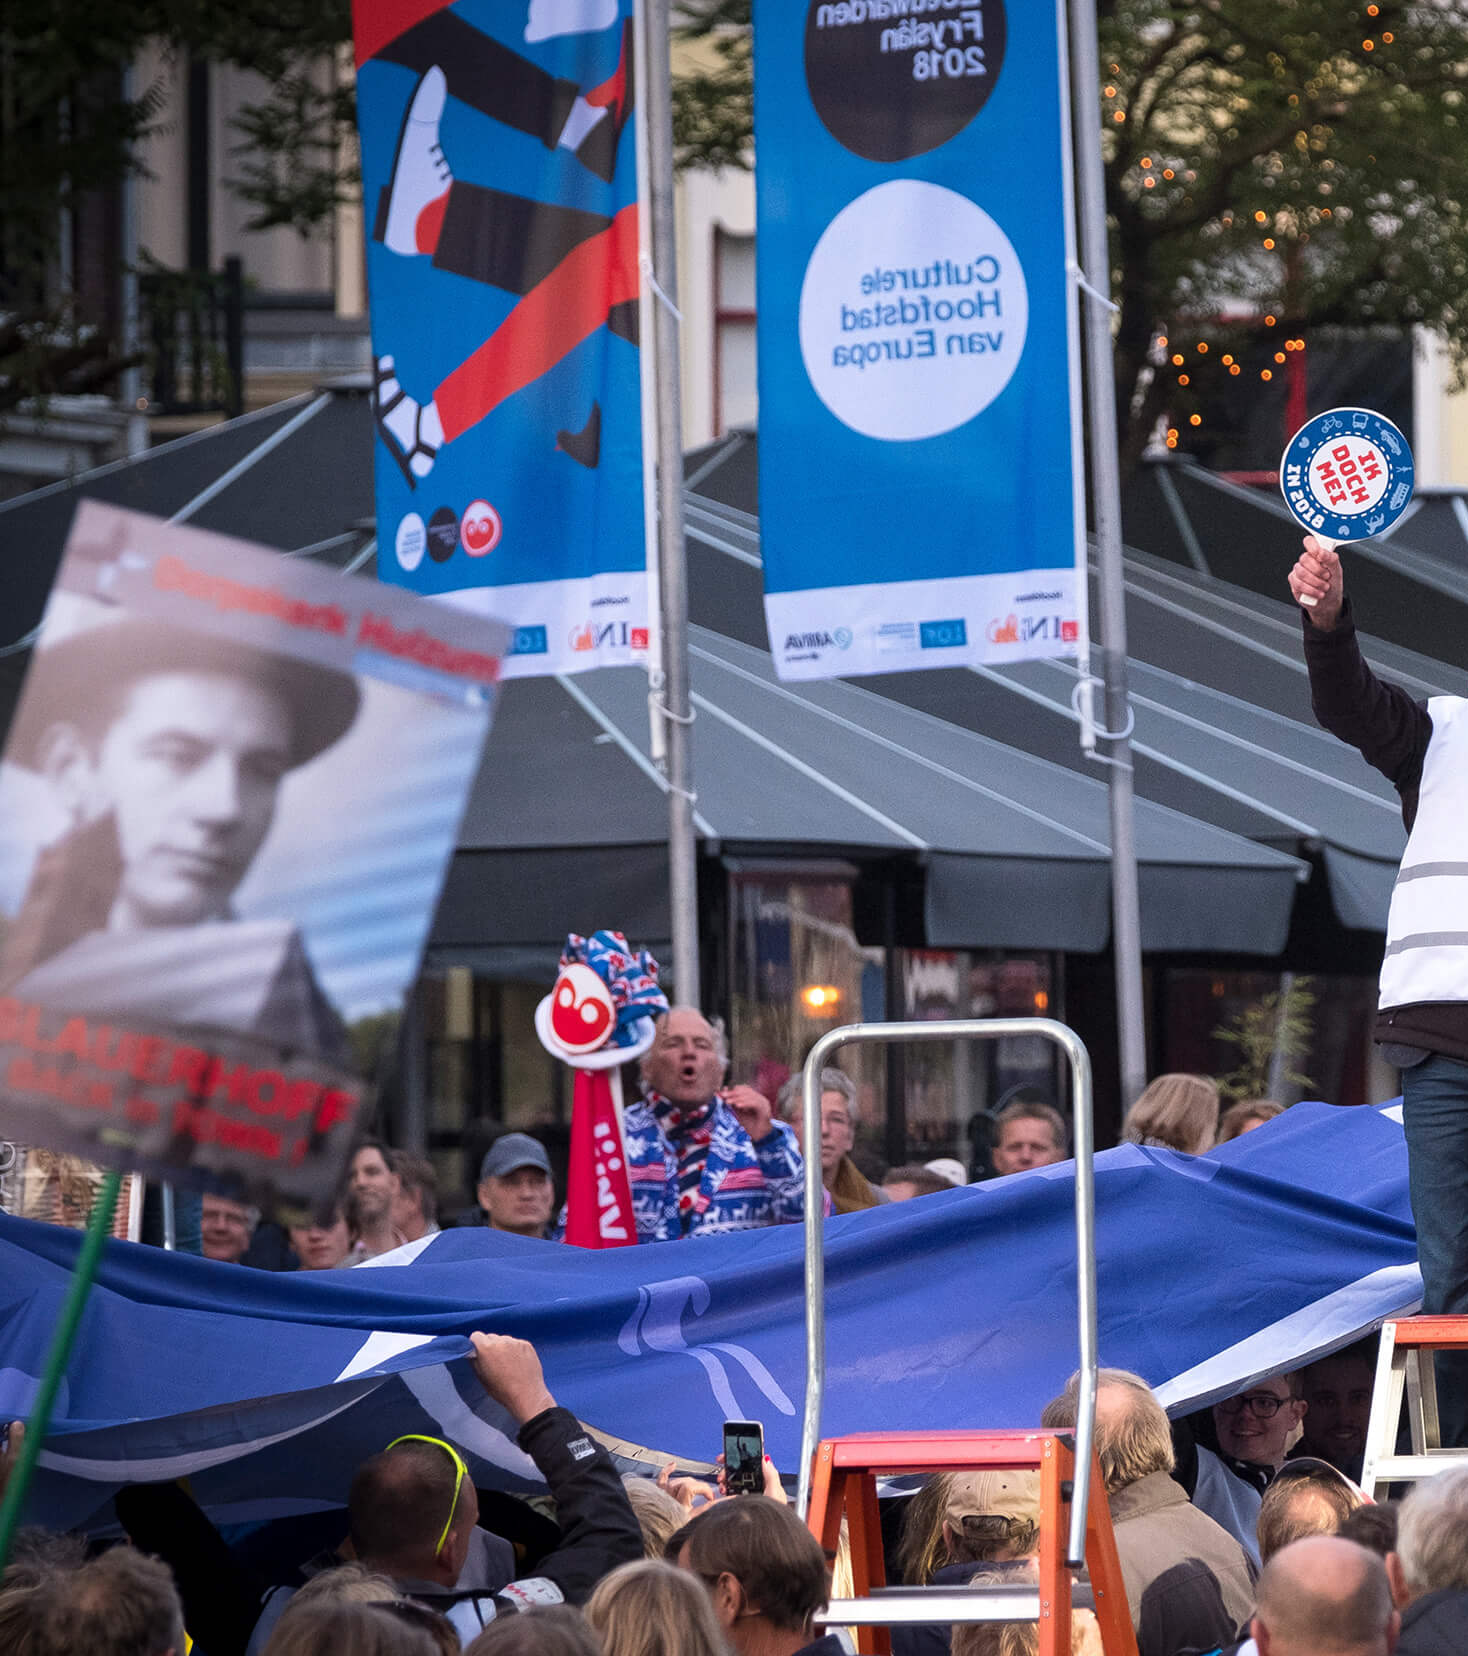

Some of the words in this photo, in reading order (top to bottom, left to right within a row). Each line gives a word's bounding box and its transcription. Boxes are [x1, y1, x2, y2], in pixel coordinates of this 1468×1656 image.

[1286, 463, 1301, 487] IN
[1315, 461, 1348, 507] MEI
[1331, 444, 1370, 505] DOCH
[1357, 450, 1383, 481] IK
[1289, 489, 1325, 529] 2018
